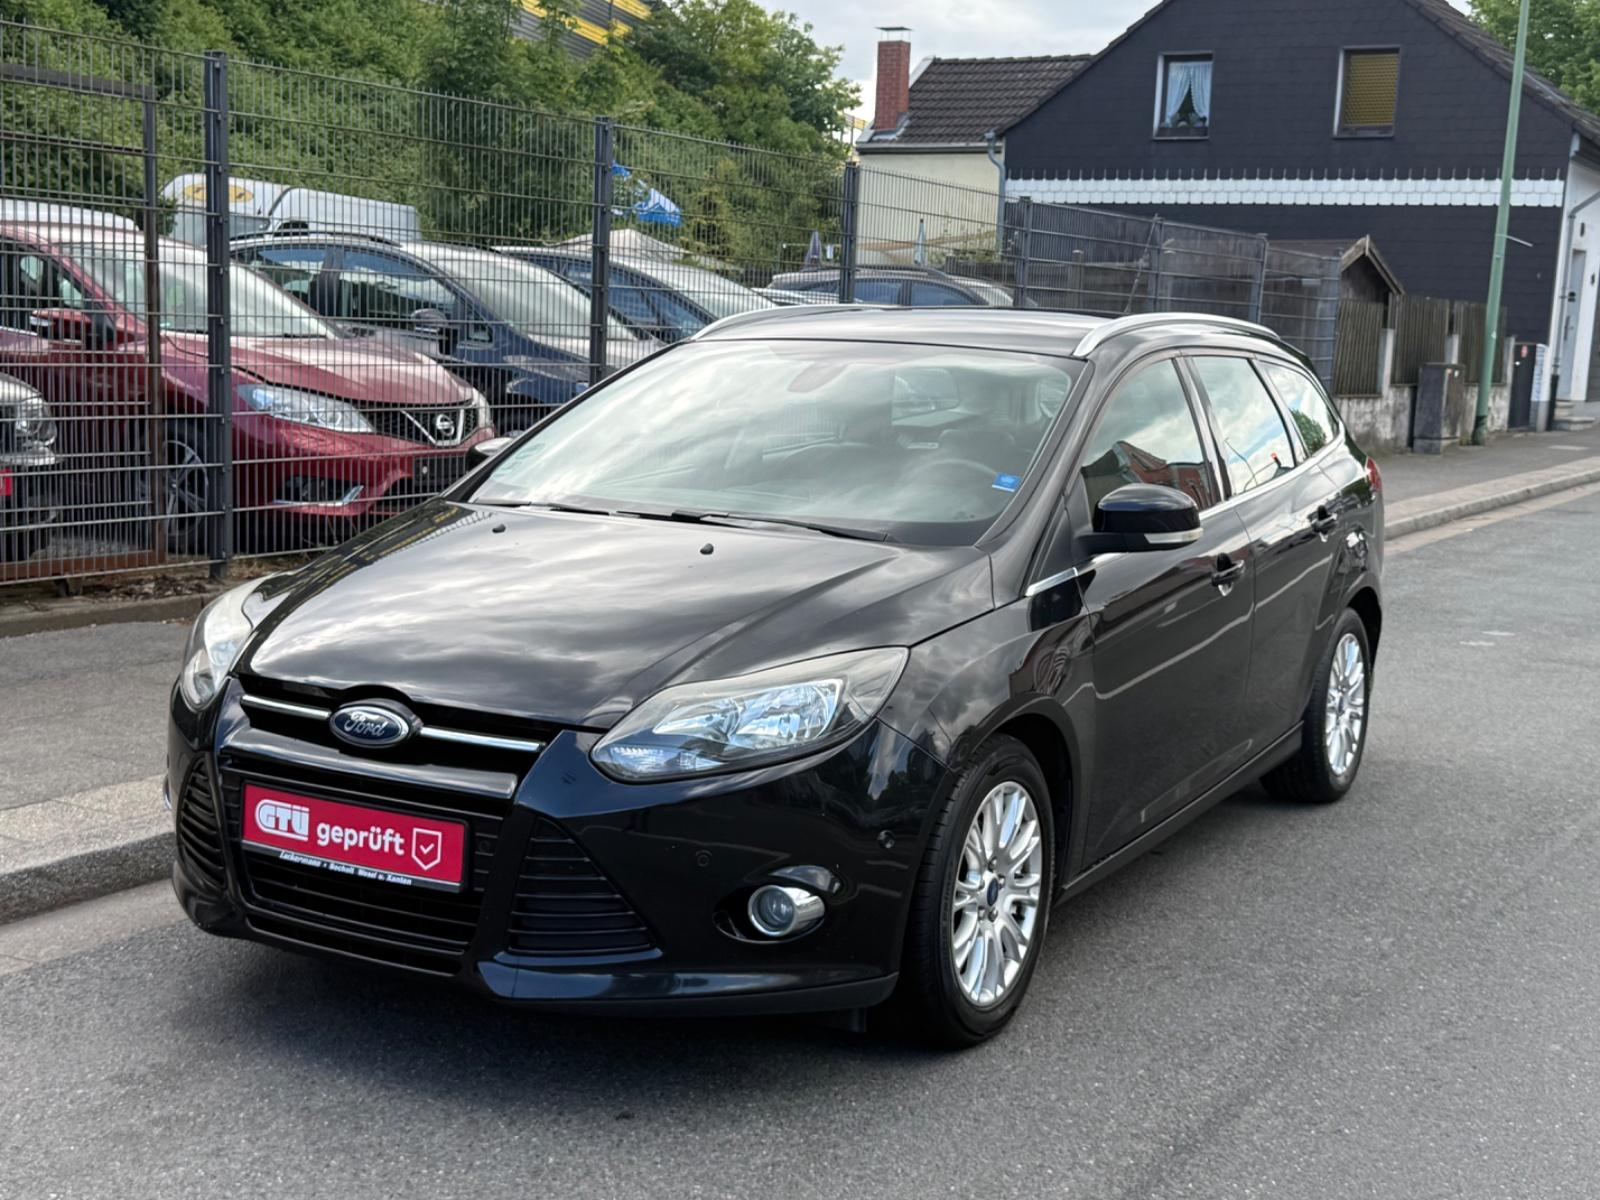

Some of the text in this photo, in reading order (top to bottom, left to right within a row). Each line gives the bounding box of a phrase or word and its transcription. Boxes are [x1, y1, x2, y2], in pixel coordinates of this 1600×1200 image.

[343, 711, 390, 737] Ford
[255, 799, 405, 855] GTÜ geprüft
